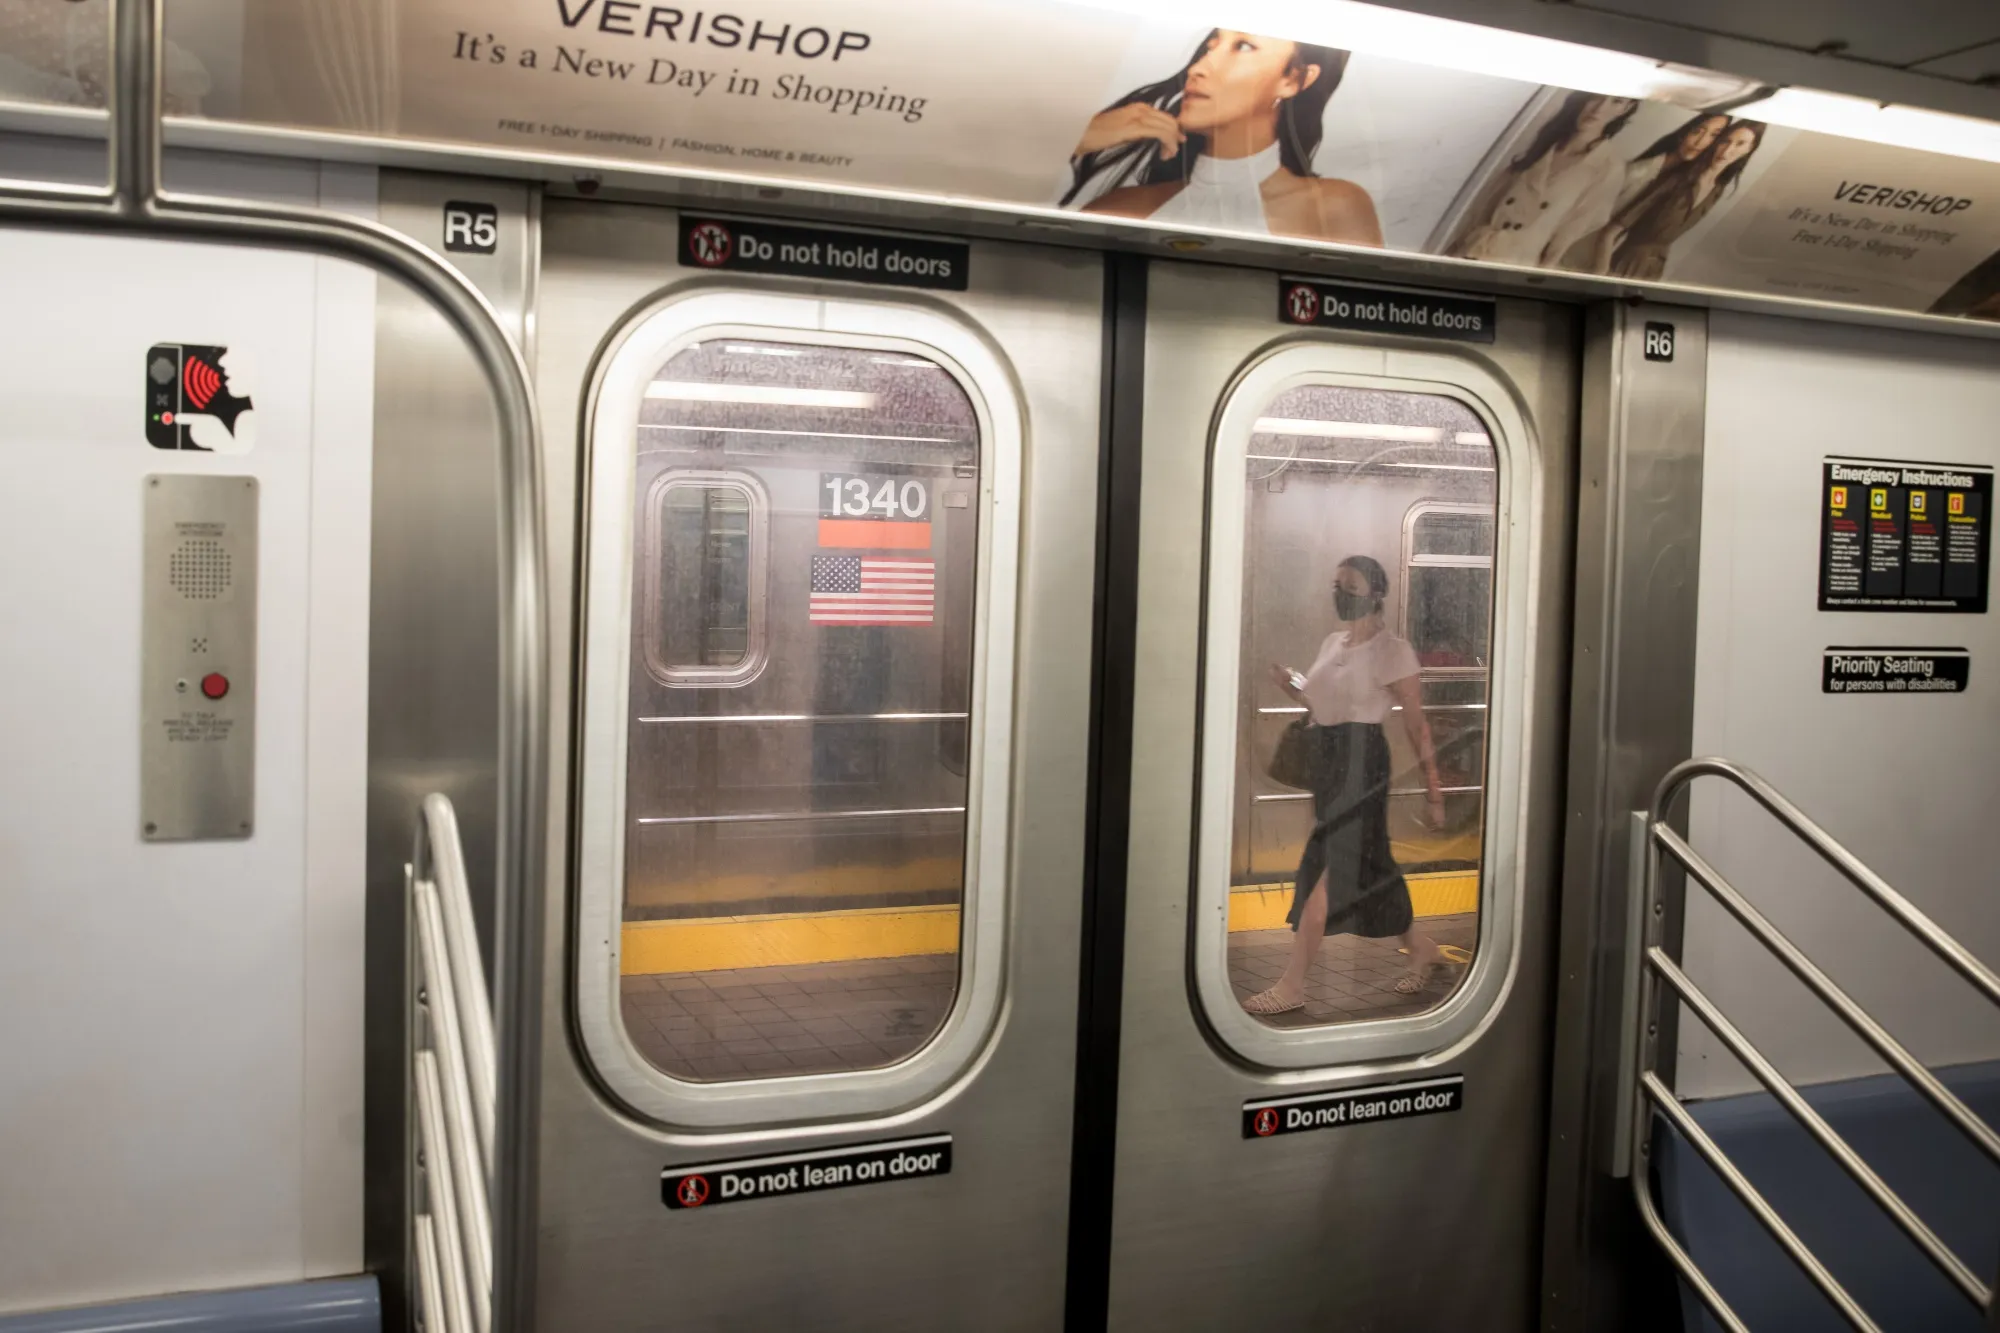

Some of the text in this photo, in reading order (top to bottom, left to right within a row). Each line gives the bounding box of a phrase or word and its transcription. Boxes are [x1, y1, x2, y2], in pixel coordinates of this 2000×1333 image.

[556, 0, 871, 62] VERISHOP
[453, 31, 928, 123] It's a New Day in Shopping
[498, 119, 536, 134] FREE
[540, 123, 581, 139] 1-DAY
[584, 129, 653, 148] SHIPPING
[741, 146, 784, 161] HOME
[798, 151, 854, 168] BEAUTY
[1834, 181, 1972, 216] VERISHOP
[445, 210, 496, 247] R5
[1791, 229, 1822, 244] Free
[1822, 212, 1851, 226] New
[738, 234, 951, 278] Do not hold doors
[1323, 295, 1482, 331] Do not hold doors
[1646, 330, 1672, 356] R6
[1831, 464, 1974, 488] Emergency Instructions
[825, 476, 927, 518] 1340
[1831, 656, 1934, 677] Priority Seating
[1830, 679, 1957, 692] for persons with disabilities
[1286, 1091, 1454, 1128] Do not lean on door
[720, 1152, 942, 1198] Do not lean on door
